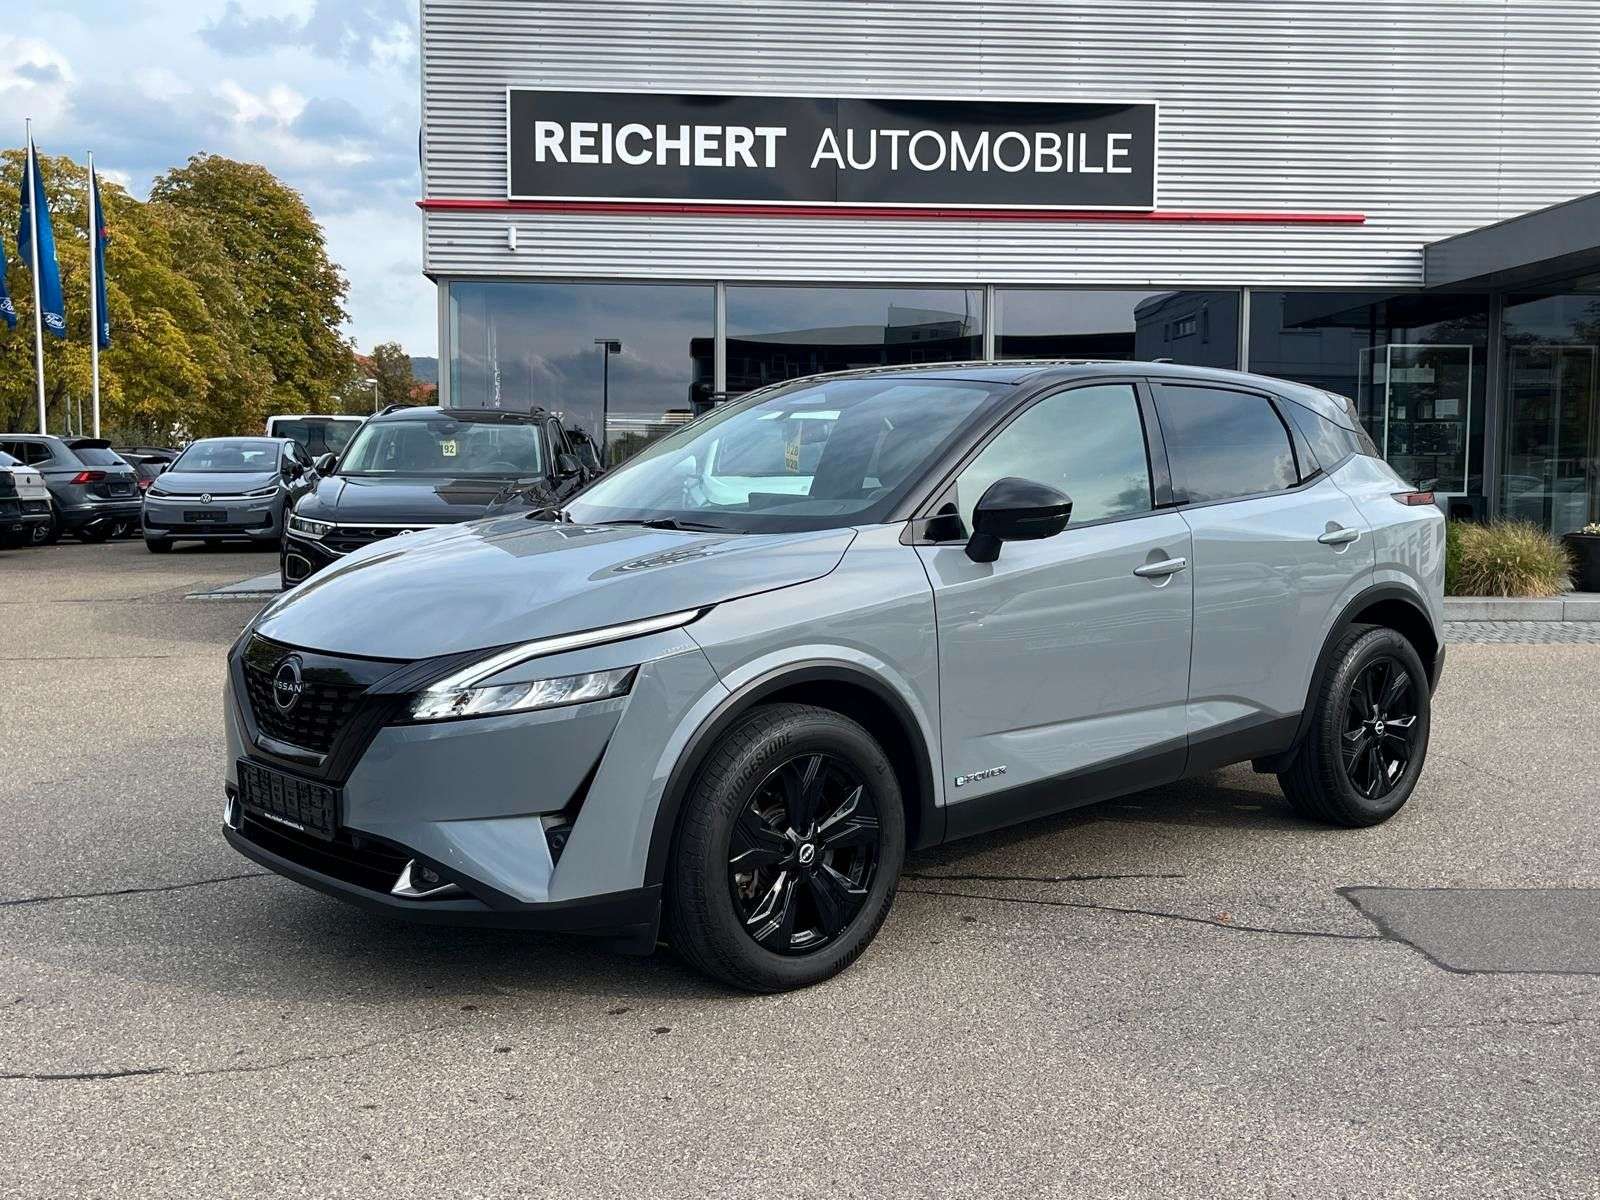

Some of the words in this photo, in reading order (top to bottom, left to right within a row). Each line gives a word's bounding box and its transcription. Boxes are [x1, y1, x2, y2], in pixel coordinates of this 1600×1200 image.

[535, 121, 786, 167] REICHERT
[811, 128, 1132, 173] AUTOMOBILE
[444, 445, 455, 454] 92
[273, 679, 302, 693] NISSAN
